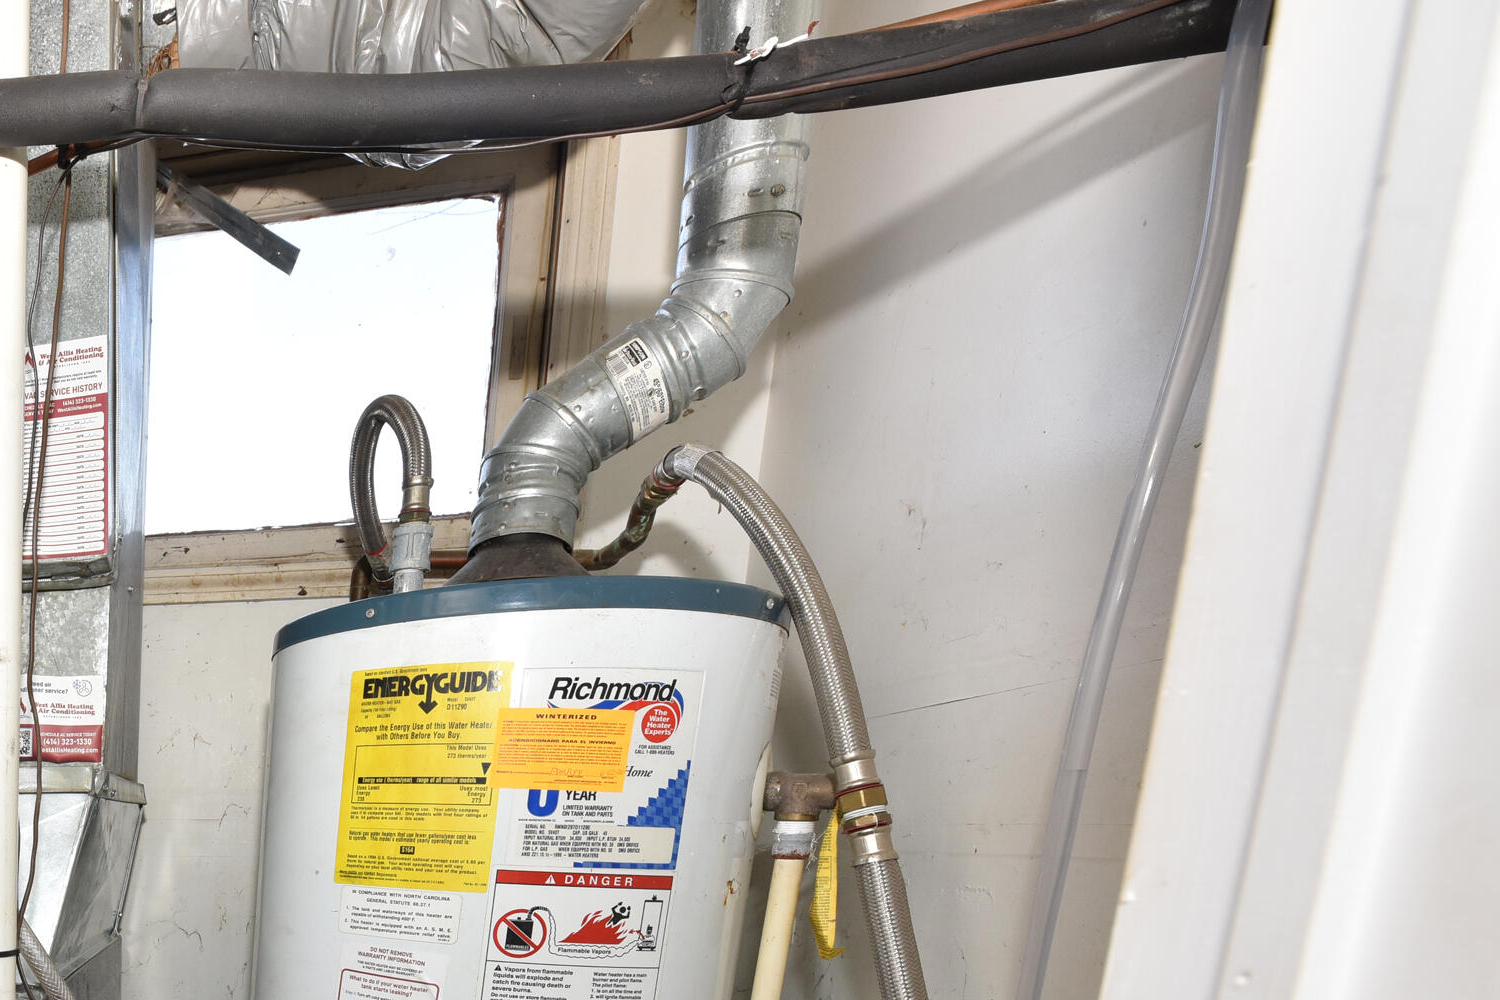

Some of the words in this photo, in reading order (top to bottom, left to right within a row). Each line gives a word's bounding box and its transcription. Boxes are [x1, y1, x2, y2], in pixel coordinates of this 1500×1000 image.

[76, 346, 102, 354] Heating
[60, 352, 104, 363] Conditioning
[40, 387, 70, 397] SRVICE
[72, 382, 103, 393] HISTORY
[548, 677, 677, 701] Richmond
[654, 708, 667, 716] The
[355, 725, 377, 733] Compare
[390, 724, 410, 732] Energy
[470, 721, 492, 729] Heater
[377, 732, 388, 740] with
[390, 731, 408, 740] Others
[411, 731, 431, 739] Before
[434, 730, 445, 739] You
[448, 730, 461, 739] Buy.
[566, 790, 597, 801] YEAR
[565, 875, 633, 886] DANGER
[358, 951, 386, 960] WARRANTY
[388, 956, 425, 966] INFORMATION
[390, 950, 412, 958] REMOVE
[381, 980, 392, 988] your
[410, 985, 429, 993] heater
[390, 988, 412, 997] leaking?
